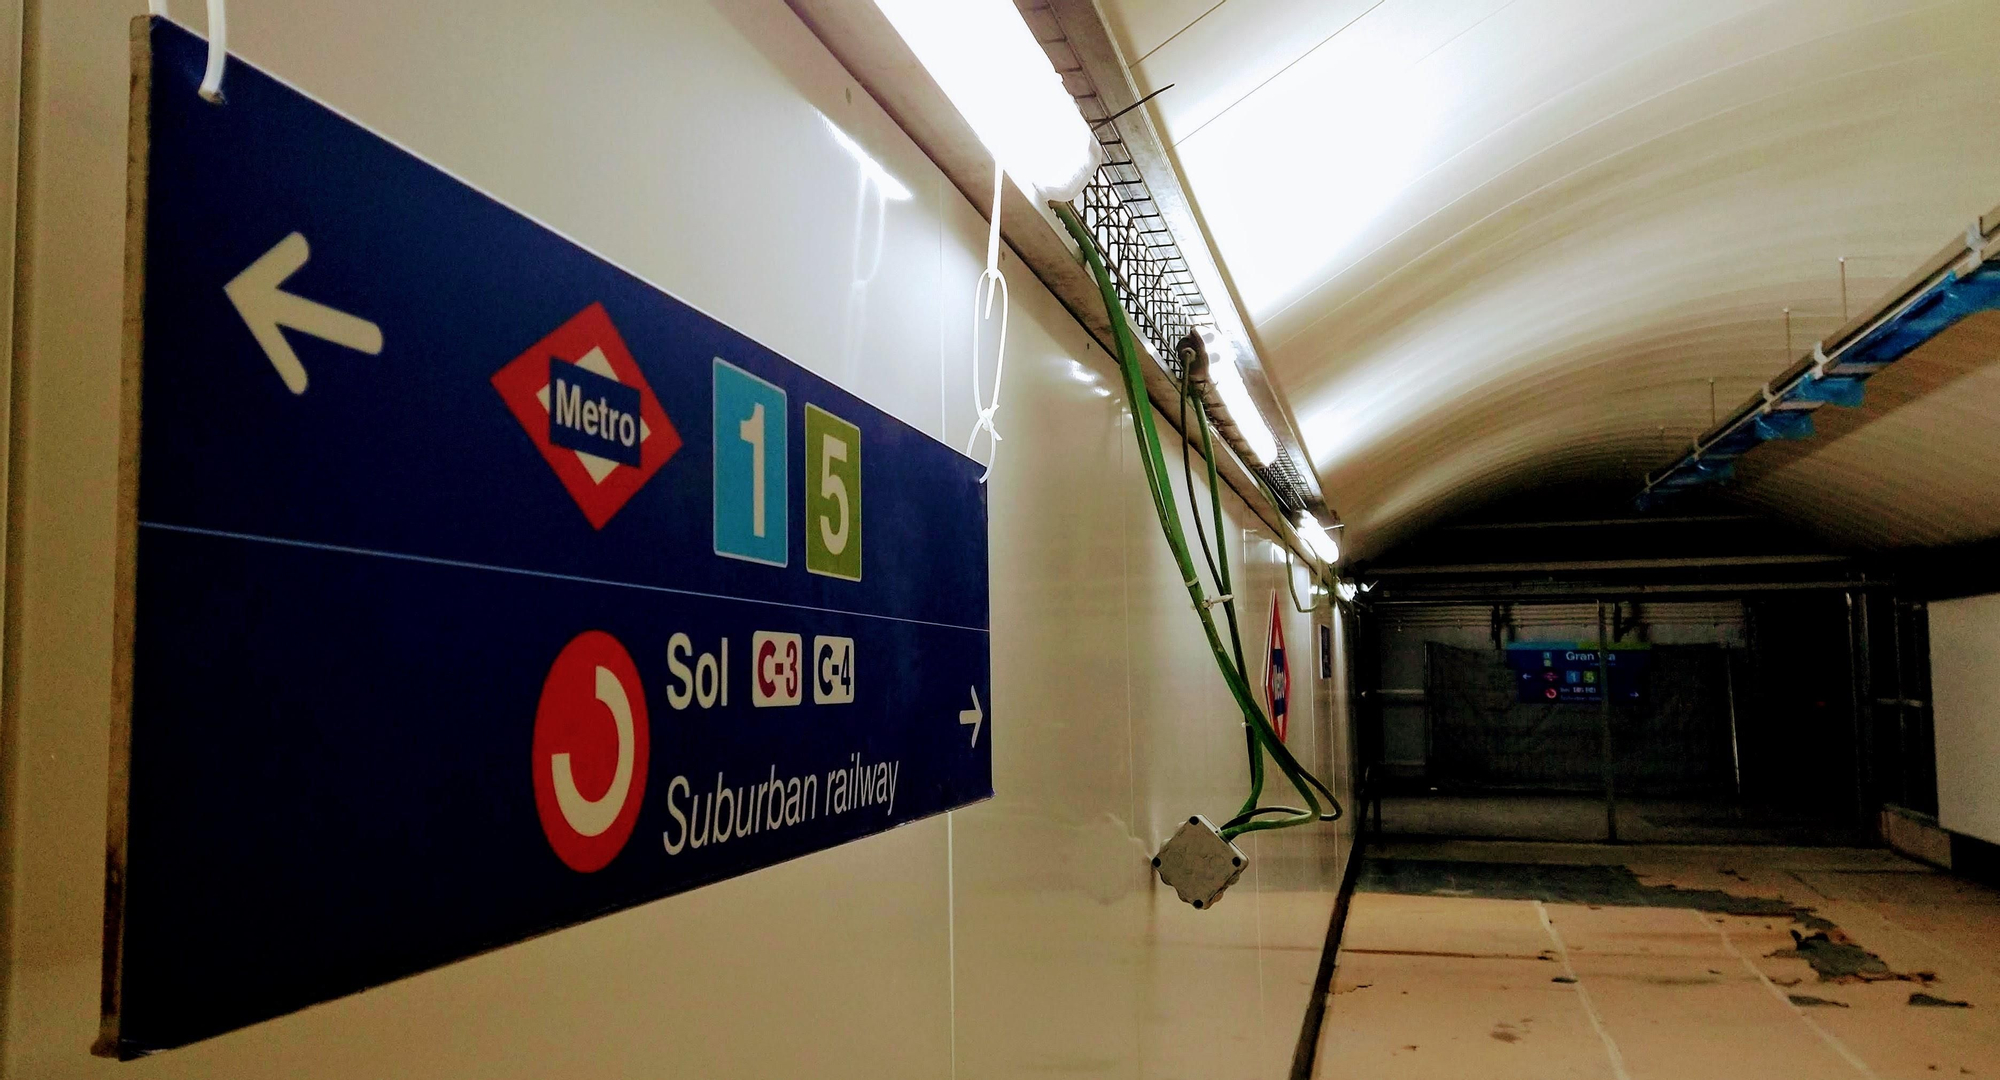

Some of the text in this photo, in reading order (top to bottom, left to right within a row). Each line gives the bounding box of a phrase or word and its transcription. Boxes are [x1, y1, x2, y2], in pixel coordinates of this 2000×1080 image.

[555, 377, 850, 556] Metro 1 5
[666, 631, 852, 710] Sol C-3 C-4
[1565, 651, 1595, 661] Gran
[662, 751, 900, 856] Suburban railway
